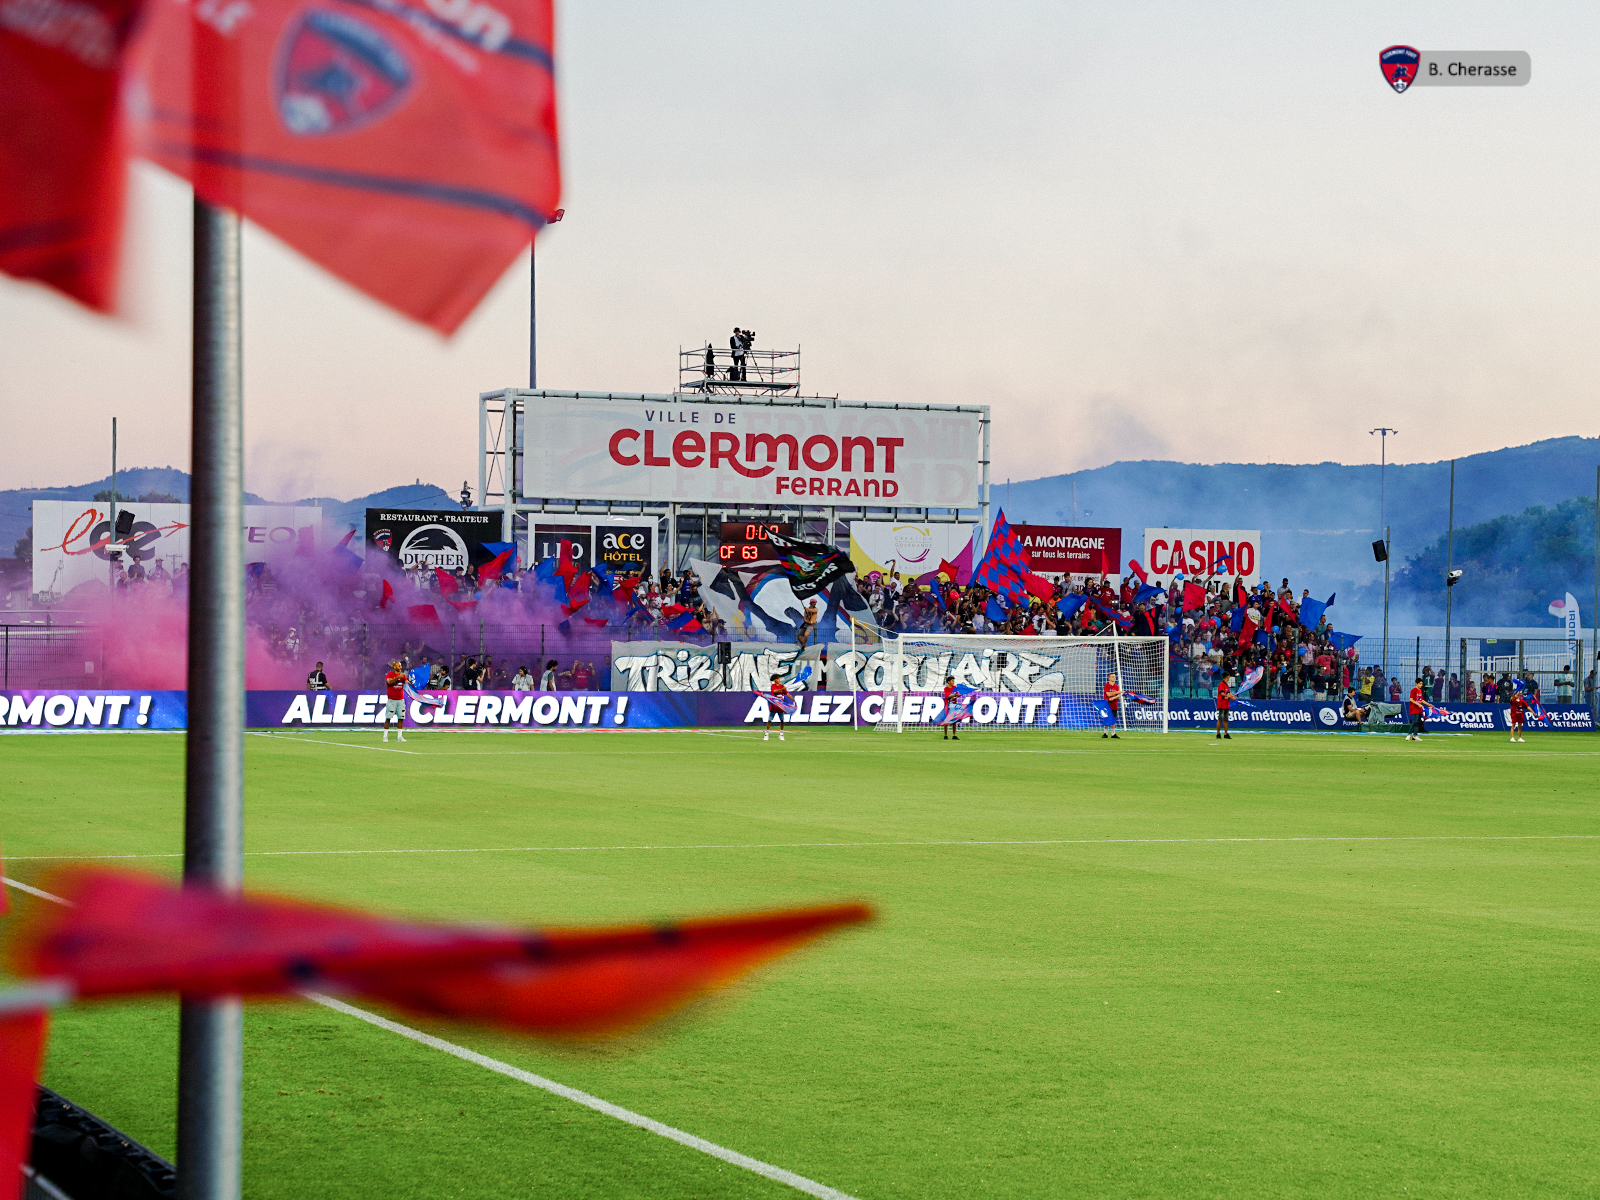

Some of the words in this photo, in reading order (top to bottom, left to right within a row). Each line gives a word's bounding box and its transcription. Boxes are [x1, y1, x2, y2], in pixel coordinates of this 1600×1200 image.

[645, 410, 700, 424] VILLE
[715, 412, 737, 425] DE
[380, 513, 438, 522] RESTAURANT
[444, 515, 489, 523] TRAITEUR
[603, 533, 645, 550] ace
[1035, 536, 1105, 550] MONTAGNE
[404, 553, 464, 566] DUCHER
[603, 551, 643, 561] HÔTEL
[720, 545, 735, 559] CF
[742, 545, 758, 559] 63
[1042, 550, 1056, 559] tous
[1056, 550, 1066, 559] les
[1067, 551, 1091, 559] terrains
[1150, 539, 1254, 577] CASINO
[136, 695, 152, 725] !
[410, 695, 608, 724] CLERMONT
[614, 696, 629, 725] !
[744, 695, 854, 722] ALEZ
[1047, 697, 1061, 724] !
[1193, 710, 1248, 722] auvegne
[1252, 709, 1312, 724] métropole
